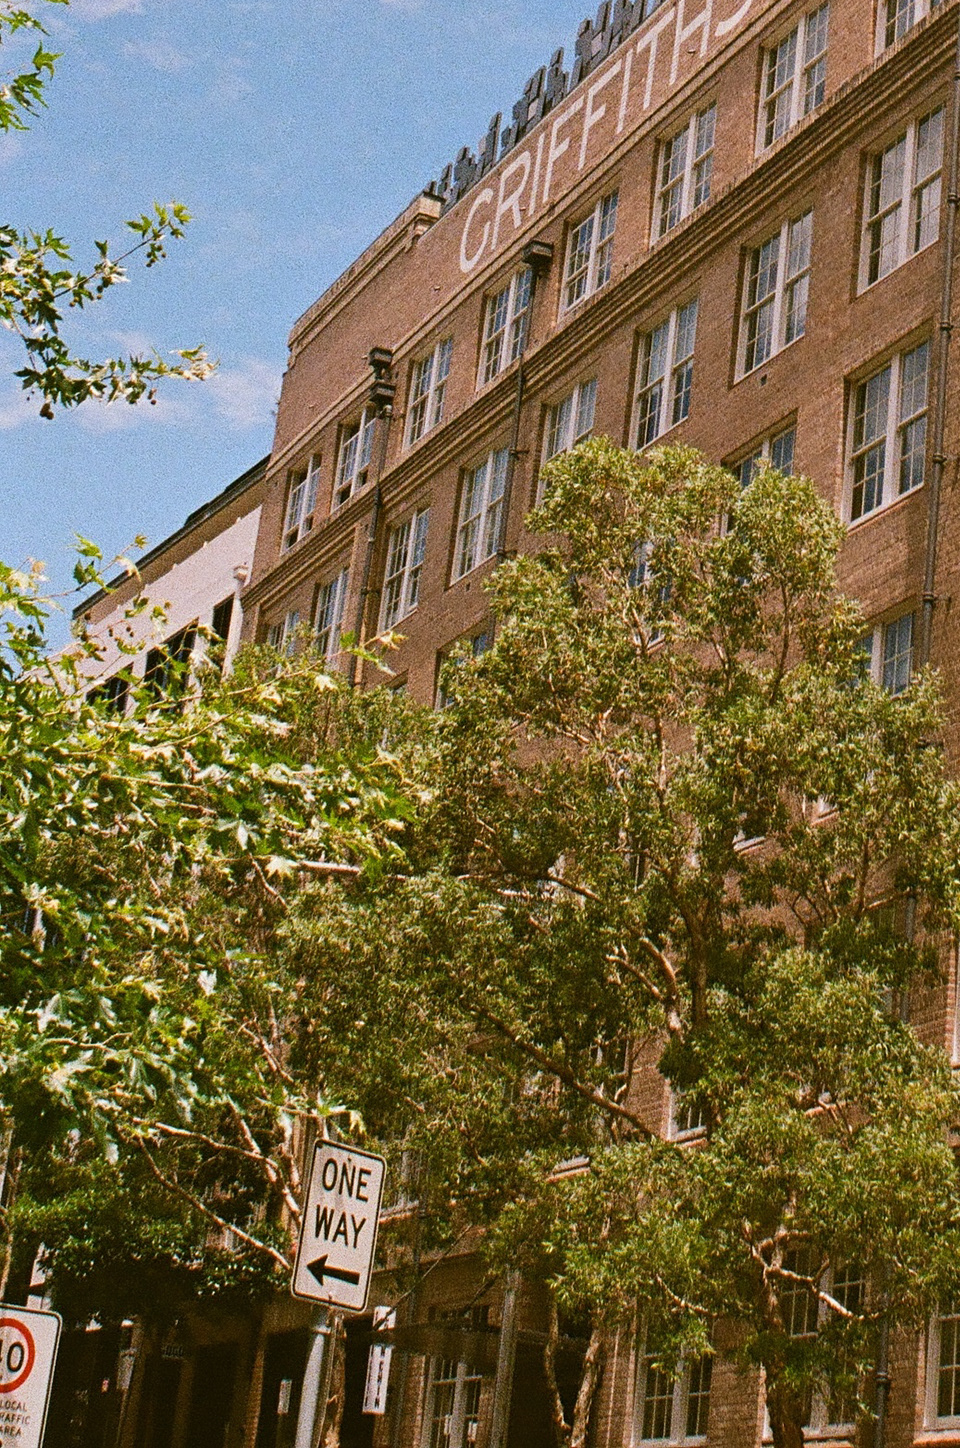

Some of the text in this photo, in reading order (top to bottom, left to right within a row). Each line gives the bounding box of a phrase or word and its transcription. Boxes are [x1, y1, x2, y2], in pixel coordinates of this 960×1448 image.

[322, 1157, 372, 1202] ONE
[314, 1204, 367, 1249] WAY
[0, 1339, 25, 1373] 0
